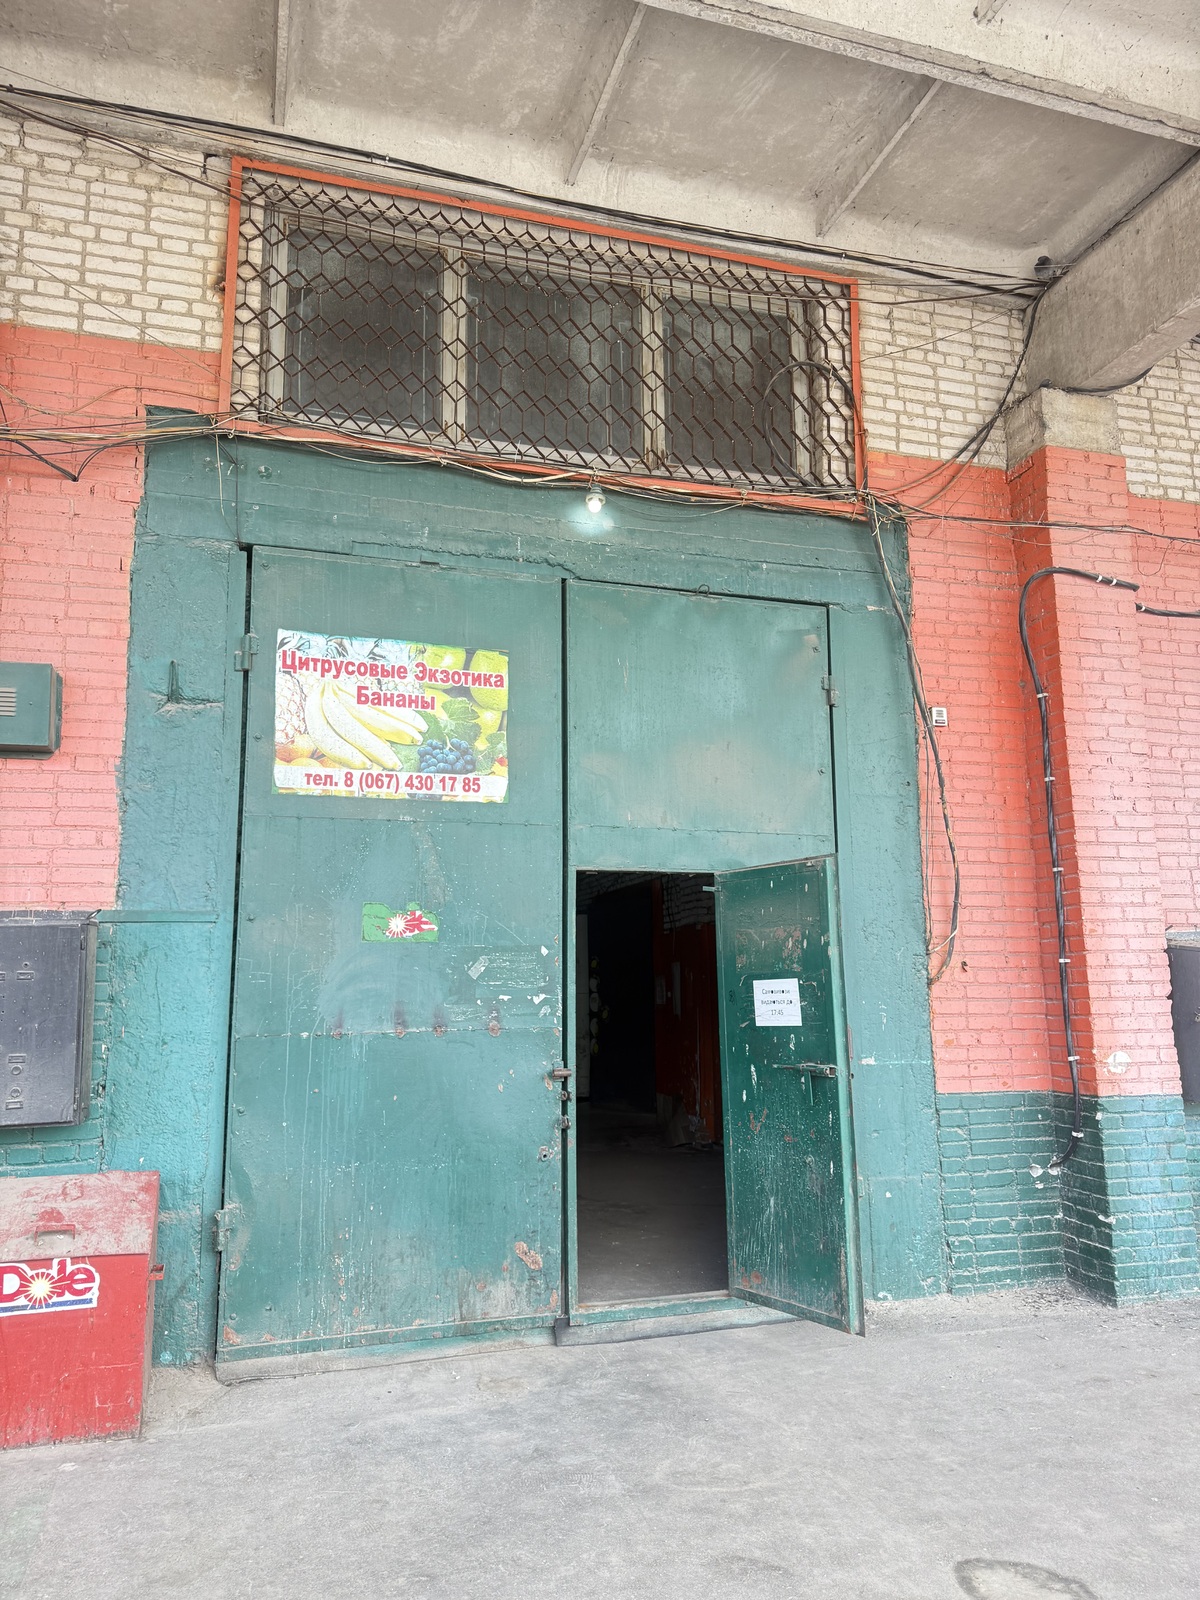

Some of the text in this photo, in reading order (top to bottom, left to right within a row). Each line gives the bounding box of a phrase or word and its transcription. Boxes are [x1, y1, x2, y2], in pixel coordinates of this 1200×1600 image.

[281, 650, 505, 688] Цитрусовые Экзотика
[356, 686, 436, 710] Бананы
[304, 771, 481, 793] тел. 8 (067) 430 17 85
[0, 1259, 96, 1305] Dole
